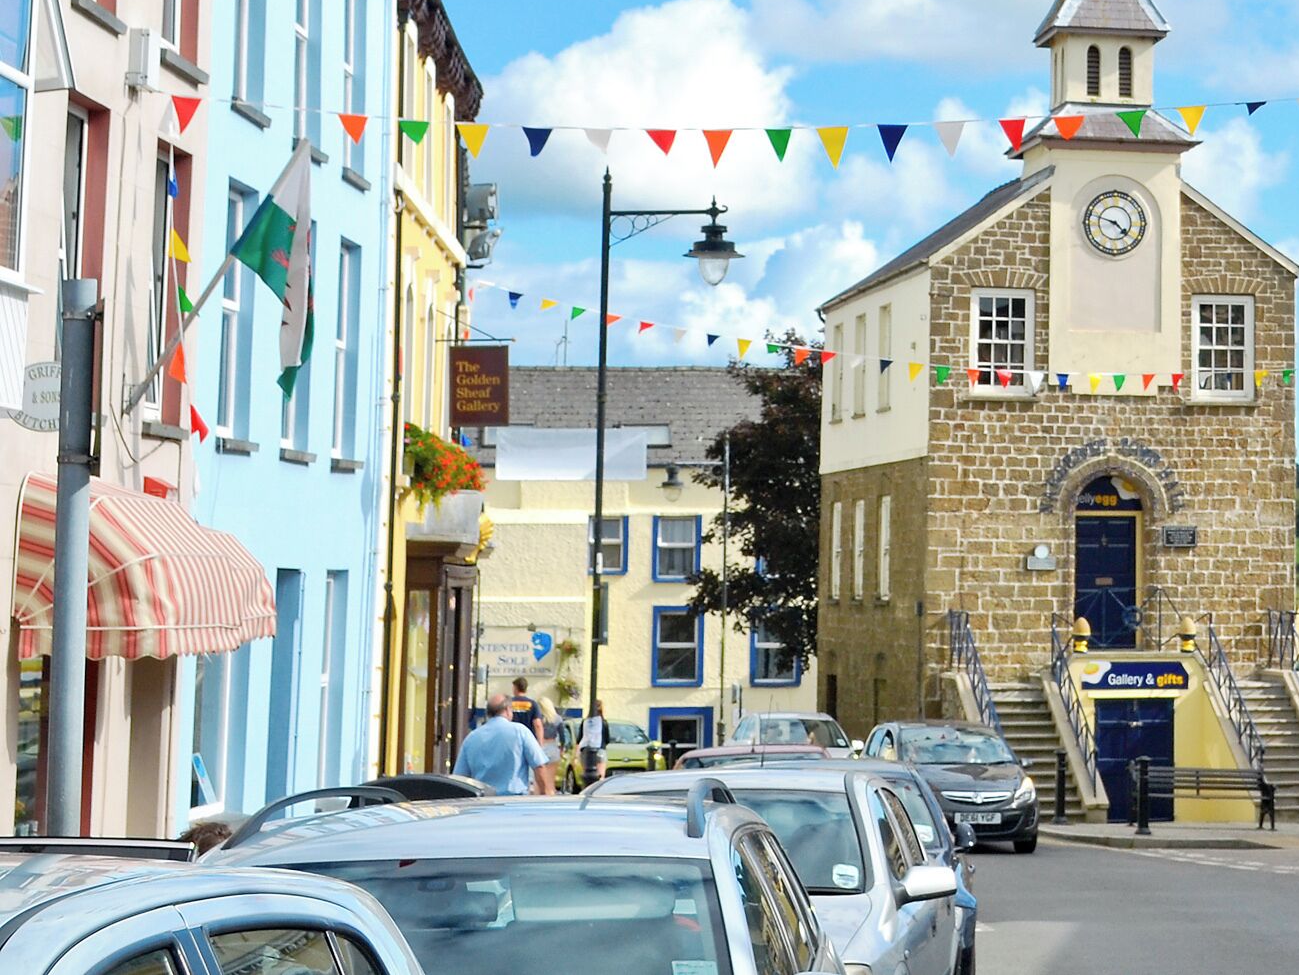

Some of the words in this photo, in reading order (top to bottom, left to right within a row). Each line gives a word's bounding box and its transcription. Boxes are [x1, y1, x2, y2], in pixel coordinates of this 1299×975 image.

[456, 361, 480, 373] The
[456, 374, 500, 385] Golden
[32, 391, 37, 404] &
[456, 387, 491, 399] Sheaf
[456, 400, 500, 413] Gallery
[14, 410, 60, 430] BUTCH
[1108, 674, 1143, 687] Gallery
[1146, 674, 1154, 685] &
[1157, 674, 1183, 687] gifts
